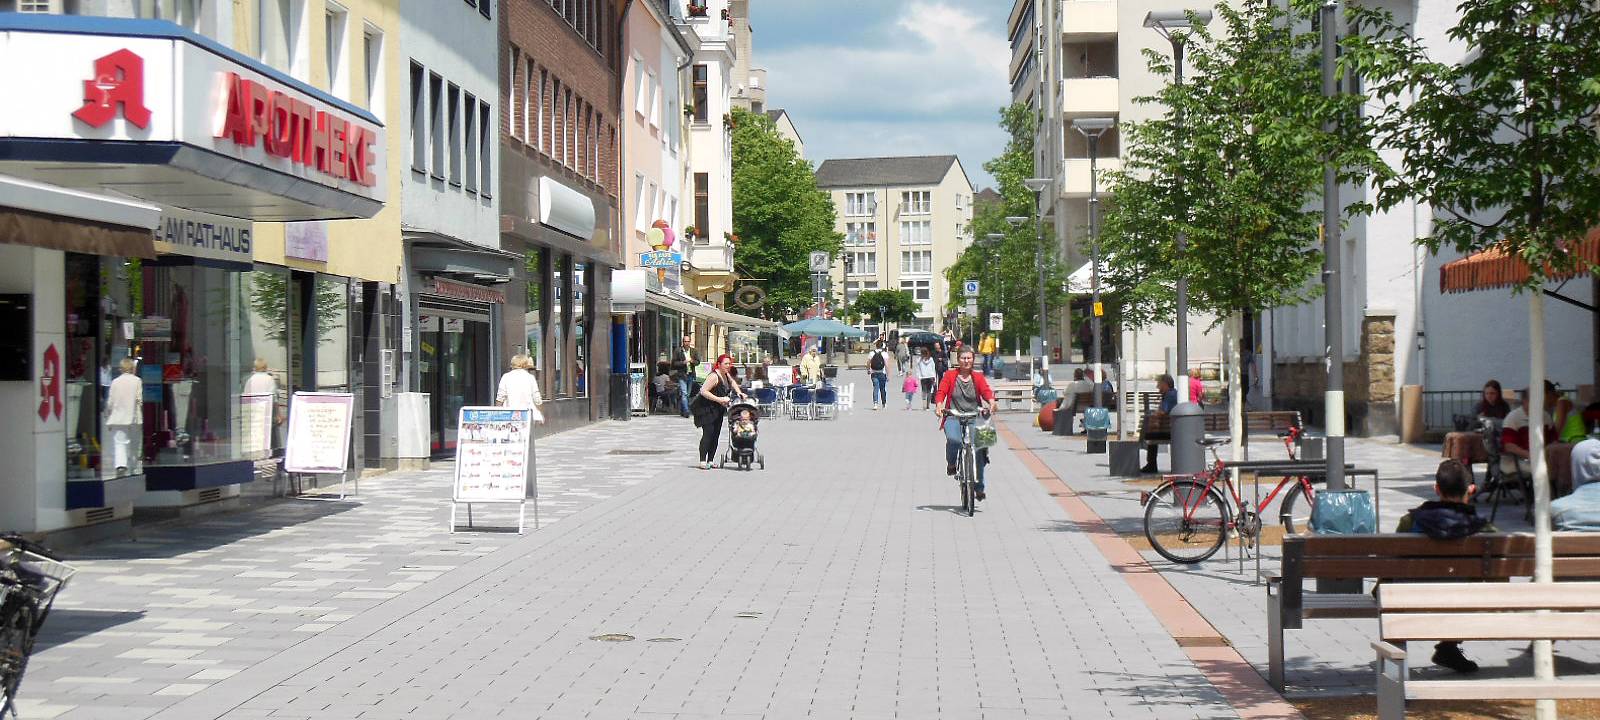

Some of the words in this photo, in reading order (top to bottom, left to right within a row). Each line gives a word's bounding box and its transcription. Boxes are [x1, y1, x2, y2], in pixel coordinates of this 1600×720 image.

[212, 72, 376, 187] APOTHEKE
[165, 218, 184, 245] AM
[186, 221, 249, 253] RATHAUS
